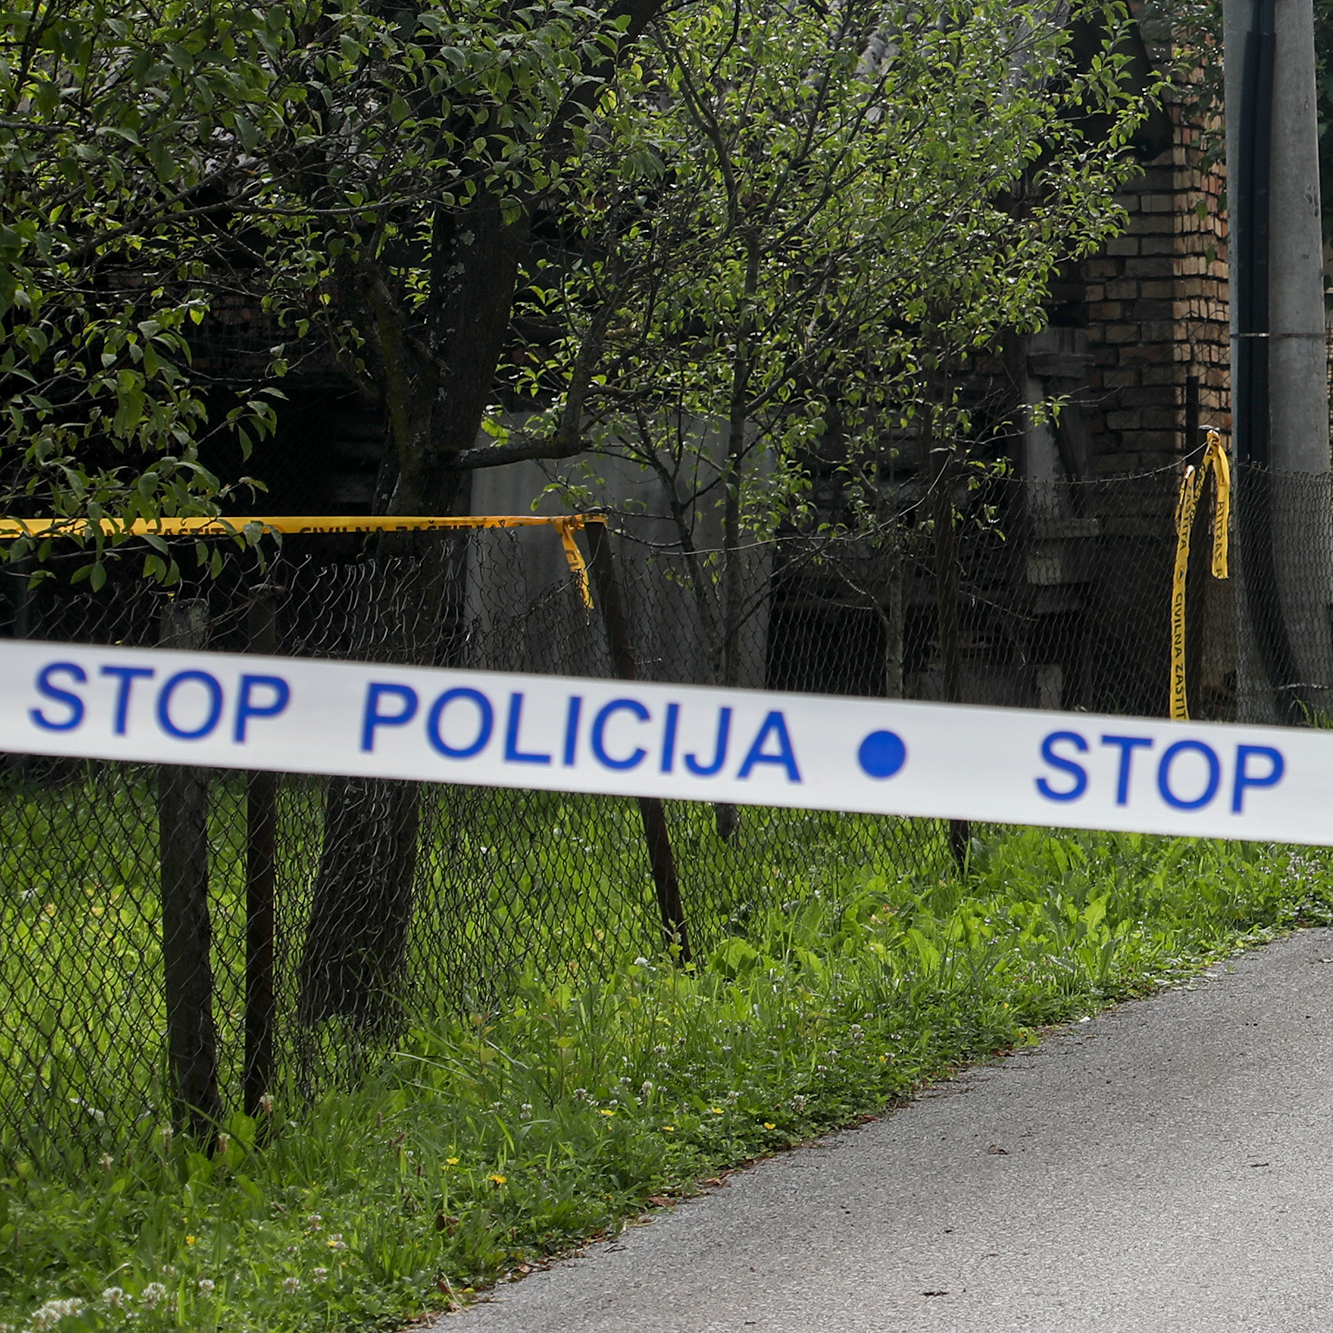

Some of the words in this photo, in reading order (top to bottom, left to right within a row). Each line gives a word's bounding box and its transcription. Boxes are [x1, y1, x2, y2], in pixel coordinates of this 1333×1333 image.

[1173, 592, 1183, 658] CIVILNA
[29, 662, 289, 742] STOP
[360, 682, 801, 783] POLICIJA
[1035, 731, 1285, 813] STOP
